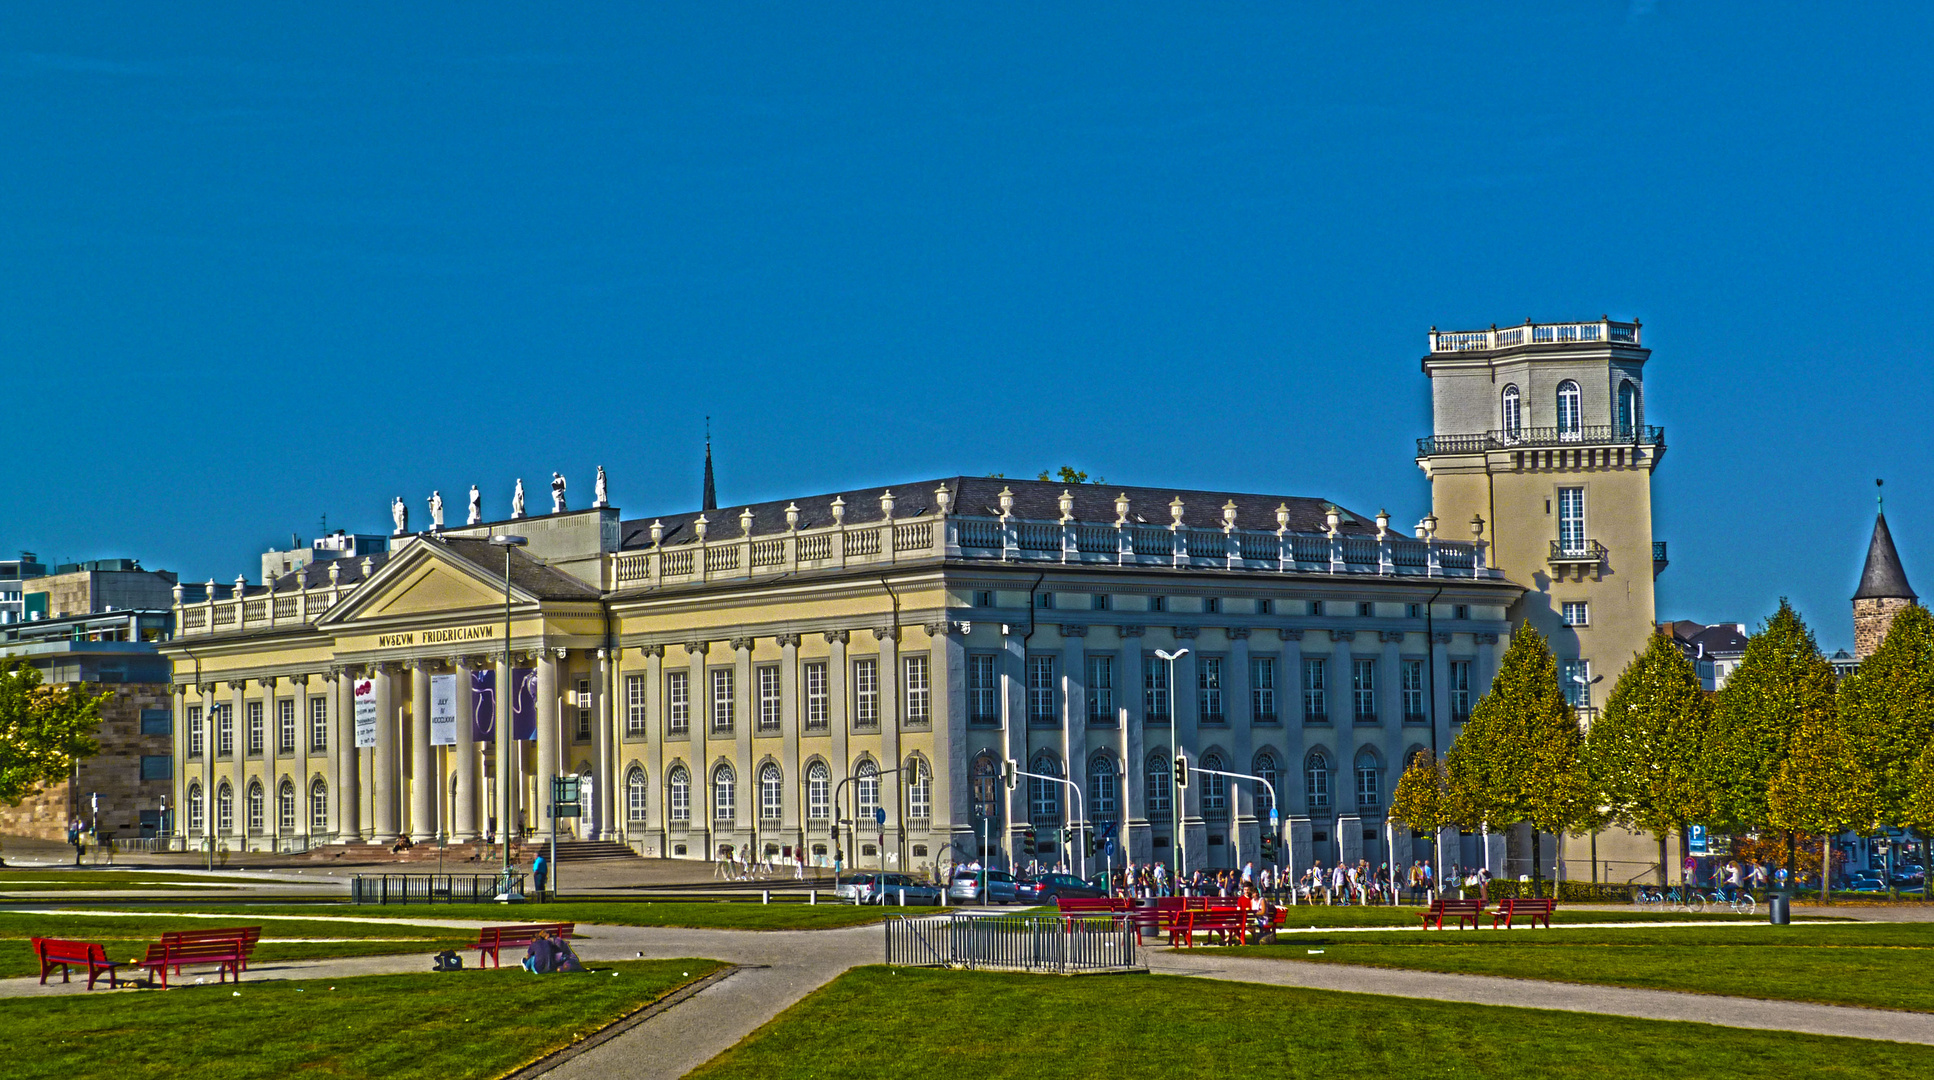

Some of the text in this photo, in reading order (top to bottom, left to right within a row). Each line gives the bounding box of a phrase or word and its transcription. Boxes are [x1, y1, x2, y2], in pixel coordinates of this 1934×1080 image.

[379, 625, 492, 647] MVSEVM FRIDERICIANVM
[1693, 825, 1701, 840] P
